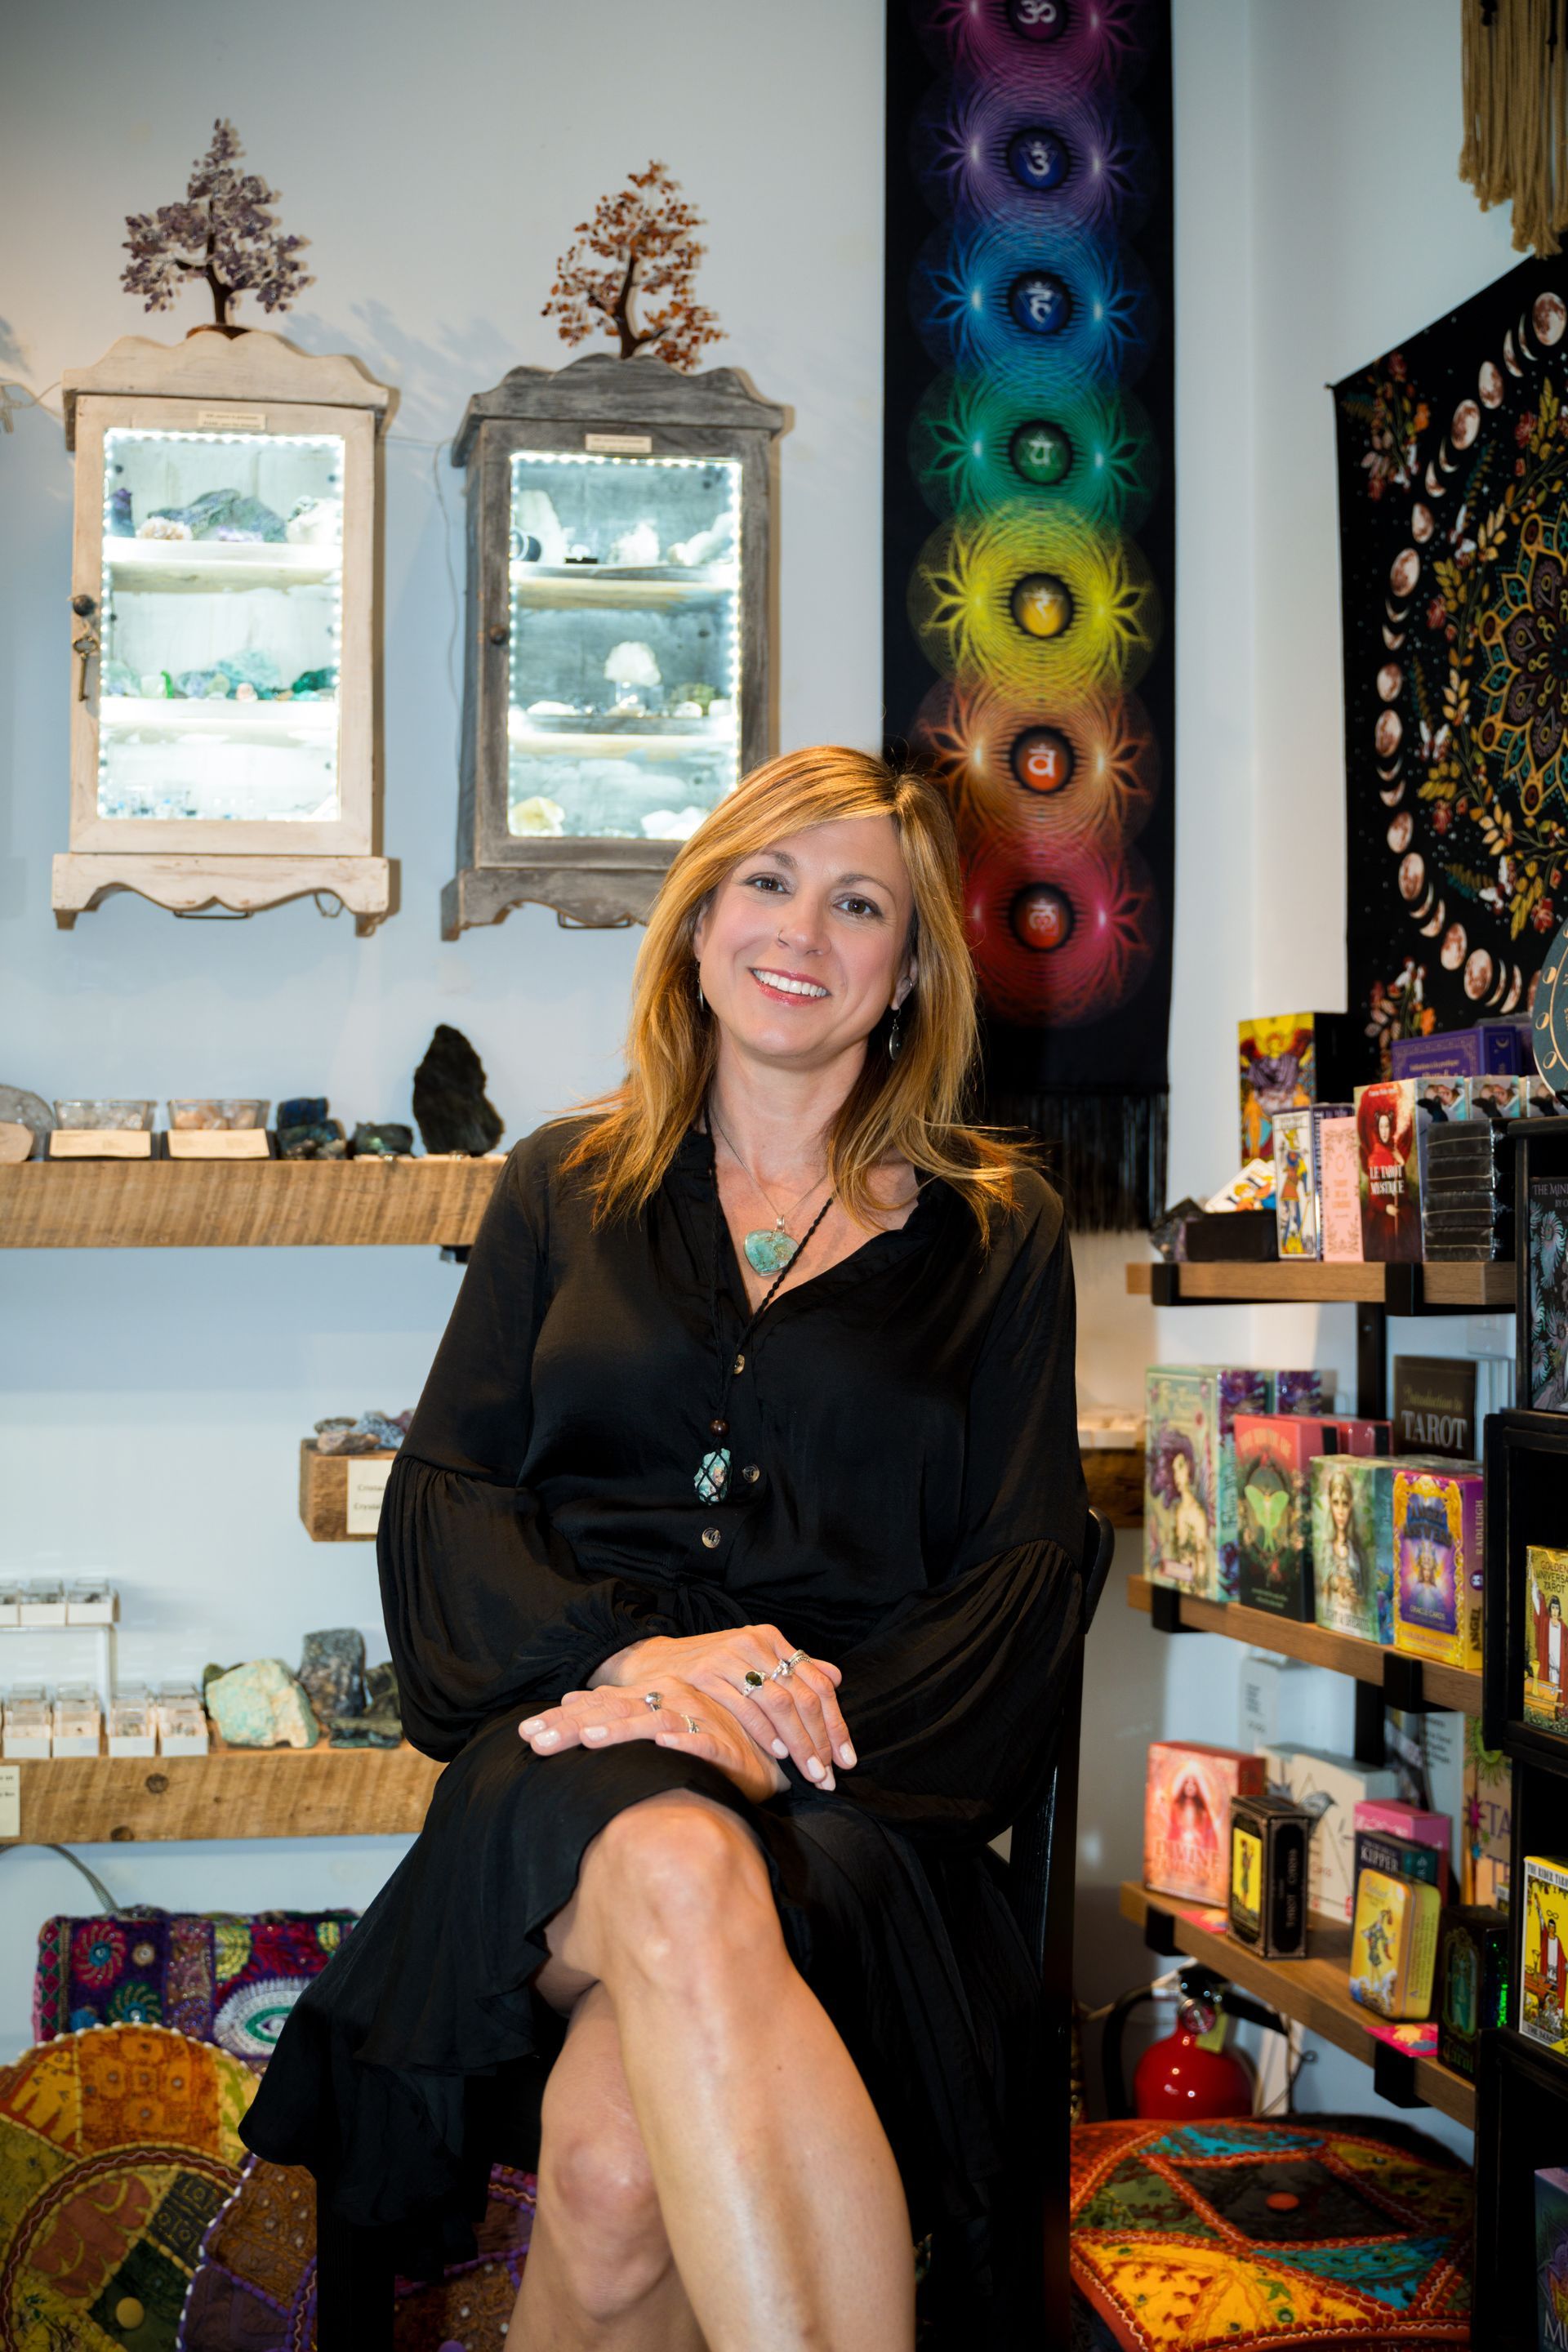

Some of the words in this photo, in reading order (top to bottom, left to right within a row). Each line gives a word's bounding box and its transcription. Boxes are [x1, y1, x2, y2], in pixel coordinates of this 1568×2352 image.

[1369, 1165, 1379, 1179] LE
[1380, 1165, 1402, 1179] TAROT
[1370, 1180, 1405, 1196] MYSTIQUE
[1533, 1184, 1548, 1196] THE
[1401, 1410, 1468, 1450] TAROT
[1410, 1503, 1445, 1525] ANGEL
[1475, 1500, 1484, 1555] RADLEIGH
[1544, 1580, 1566, 1594] TAROT
[1469, 1606, 1482, 1651] ANGEL
[1153, 1840, 1221, 1870] DIVINE
[1360, 1845, 1399, 1873] KIPPER
[1527, 1863, 1537, 1876] THE
[1538, 1866, 1554, 1882] RIDER
